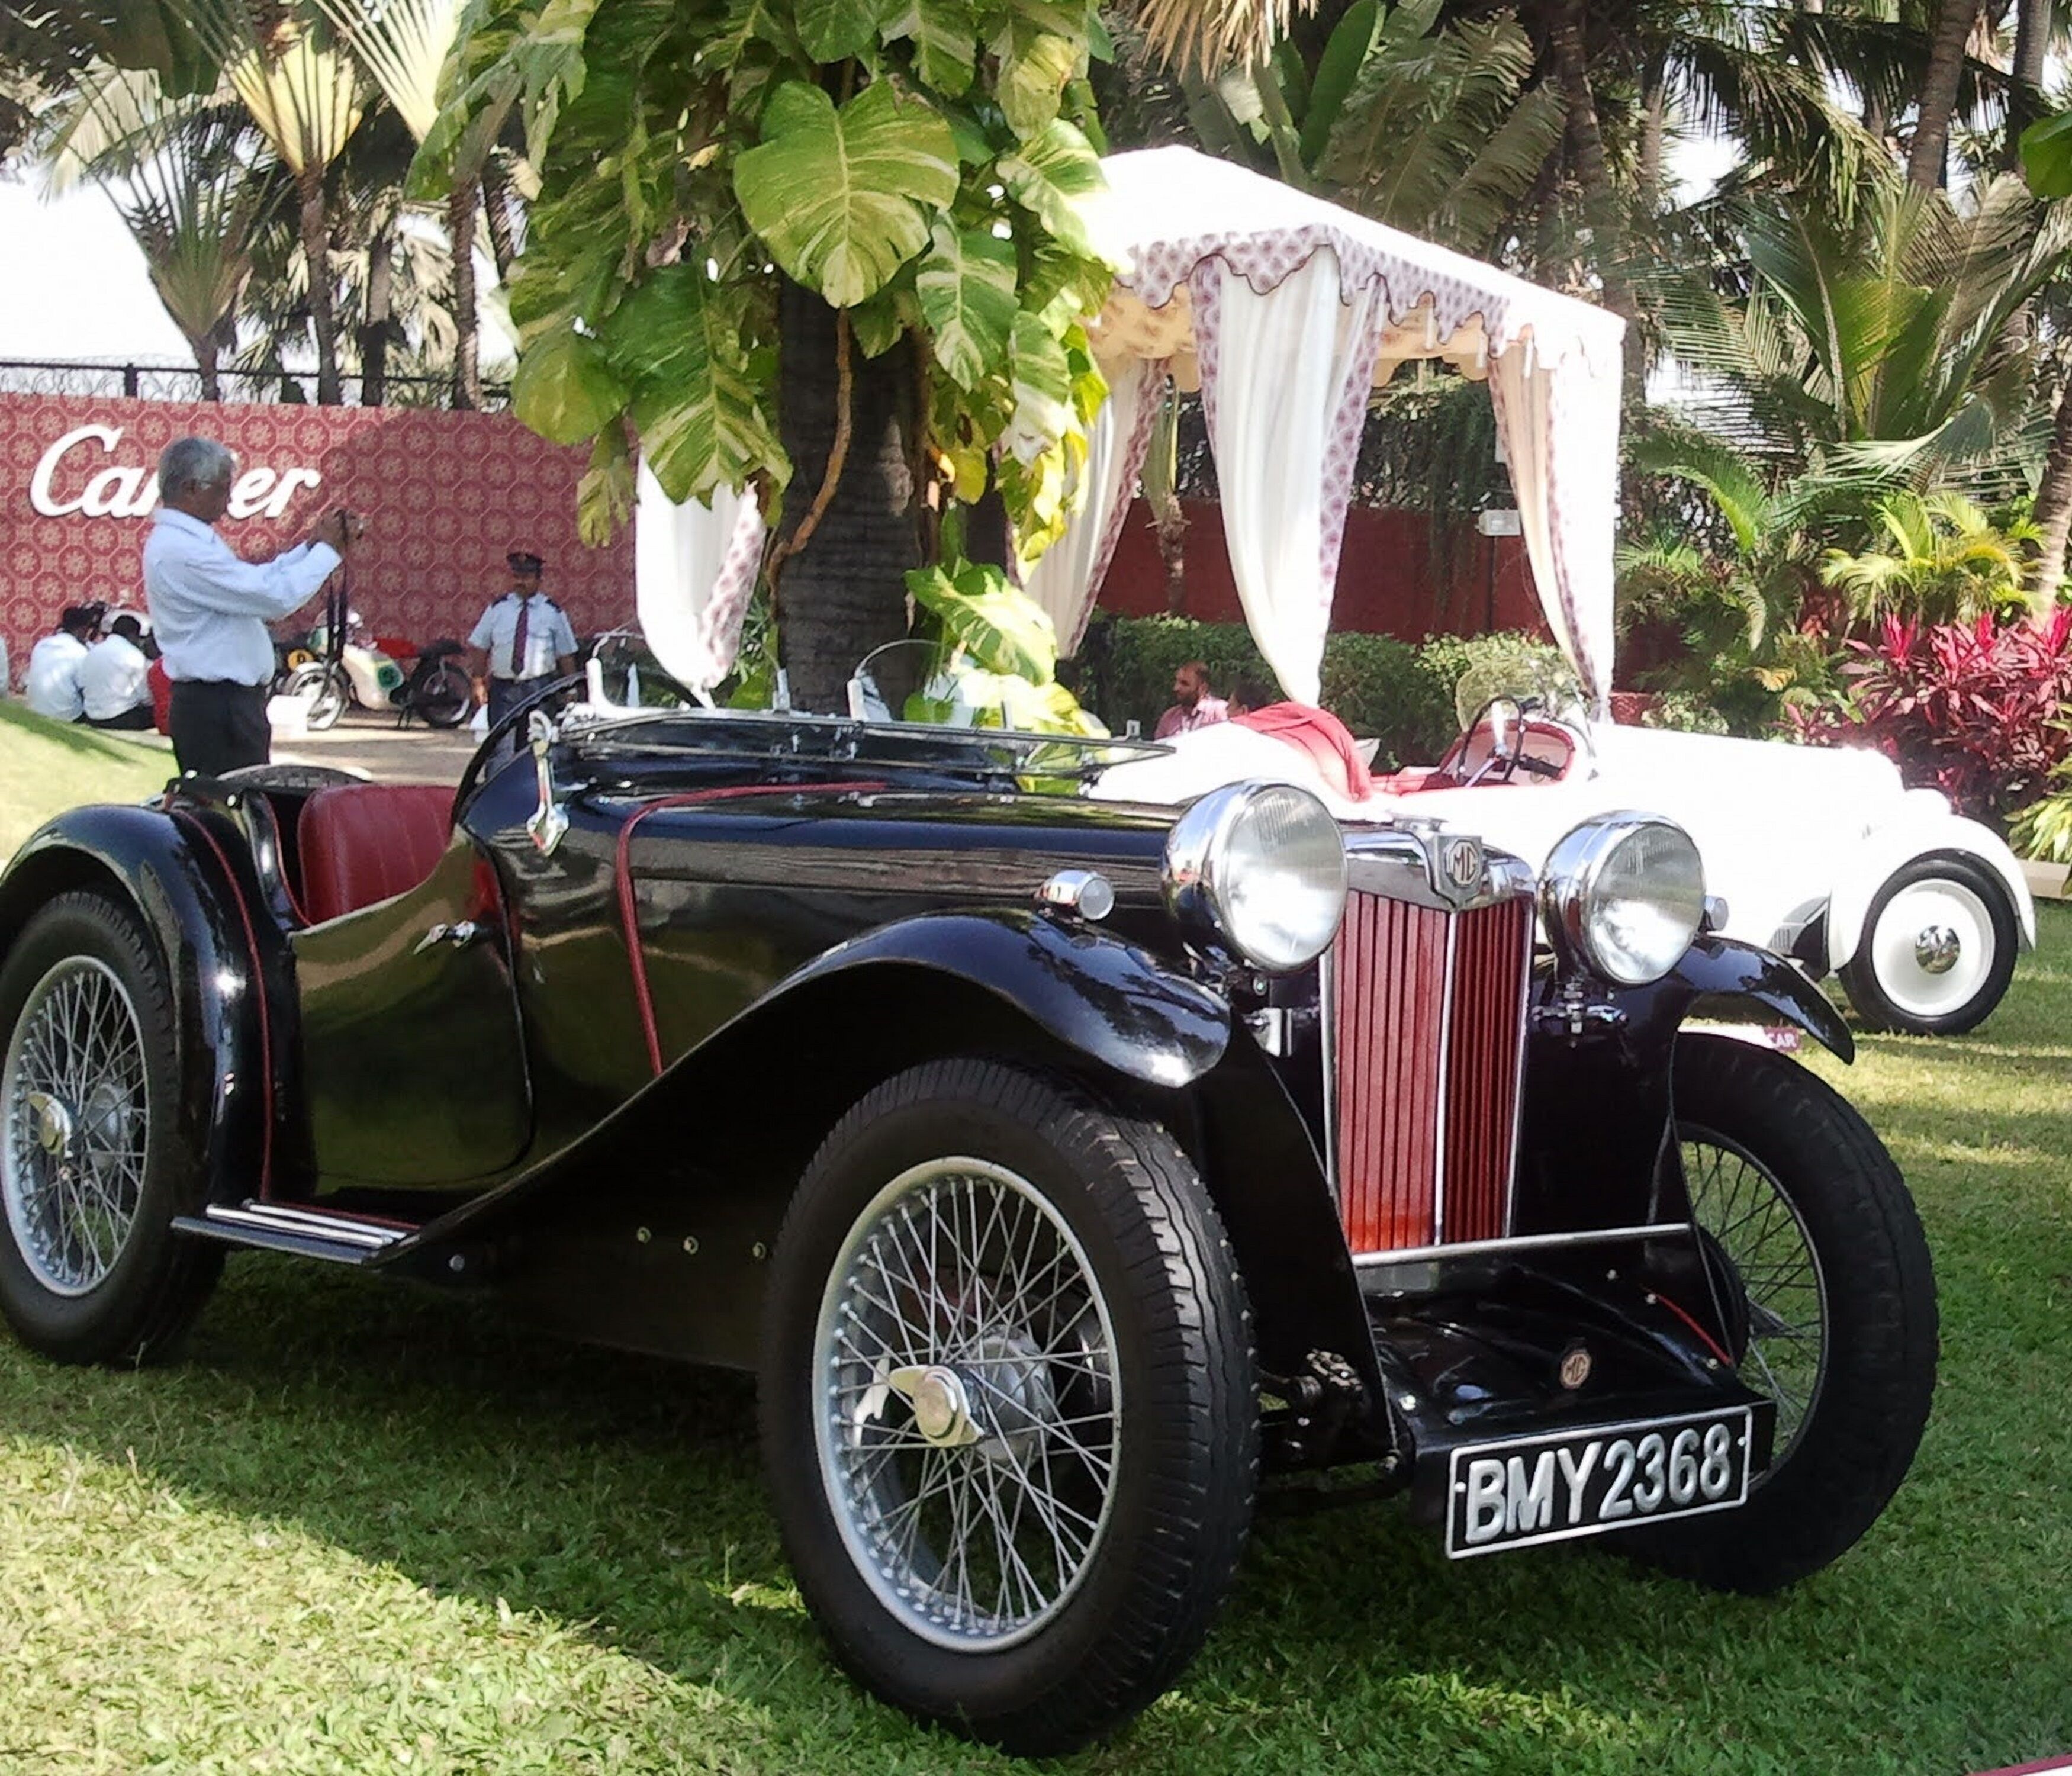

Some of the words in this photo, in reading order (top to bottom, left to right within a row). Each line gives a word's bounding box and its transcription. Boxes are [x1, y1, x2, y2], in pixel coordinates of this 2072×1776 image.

[30, 424, 321, 519] Caer
[1453, 845, 1476, 881] MG
[1564, 1356, 1586, 1382] MG
